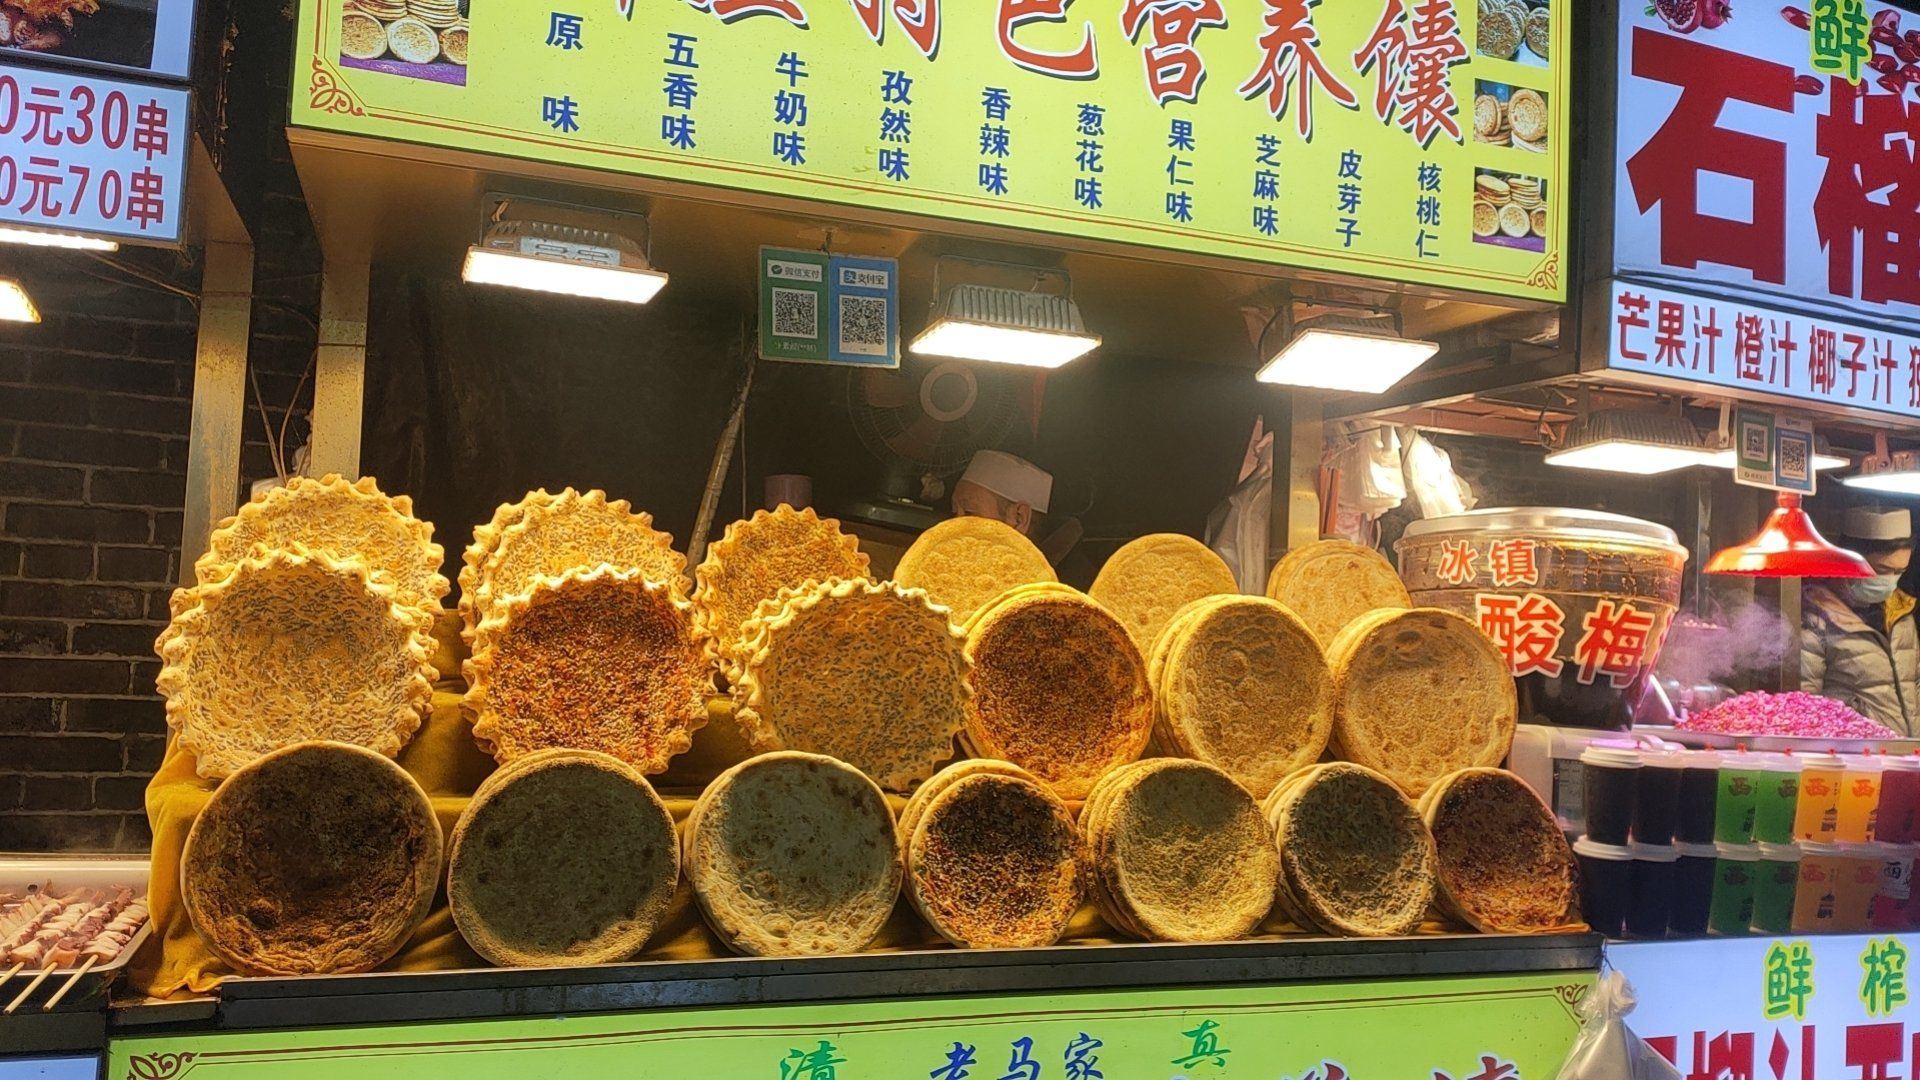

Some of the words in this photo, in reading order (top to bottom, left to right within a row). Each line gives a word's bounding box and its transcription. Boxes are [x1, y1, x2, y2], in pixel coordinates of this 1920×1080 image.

[661, 32, 699, 150] 五香味
[1814, 0, 1869, 81] 鲜
[773, 52, 809, 165] 牛奶味
[879, 70, 913, 181] 孜然味
[979, 87, 1011, 196] 香辣味
[1075, 103, 1106, 209] 葱花味
[1166, 119, 1195, 223] 果仁味
[1252, 134, 1281, 236] 芝麻味
[1335, 150, 1363, 247] 皮芽子
[1415, 161, 1442, 258] 核桃仁
[858, 273, 885, 286] 支付宝
[1618, 291, 1722, 374] 芒果汁
[1735, 312, 1797, 388] 橙汁
[1811, 325, 1898, 404] 椰子汁
[1437, 540, 1538, 585] 冰镇
[1476, 593, 1675, 688] 酸梅
[1171, 1019, 1231, 1069] 真
